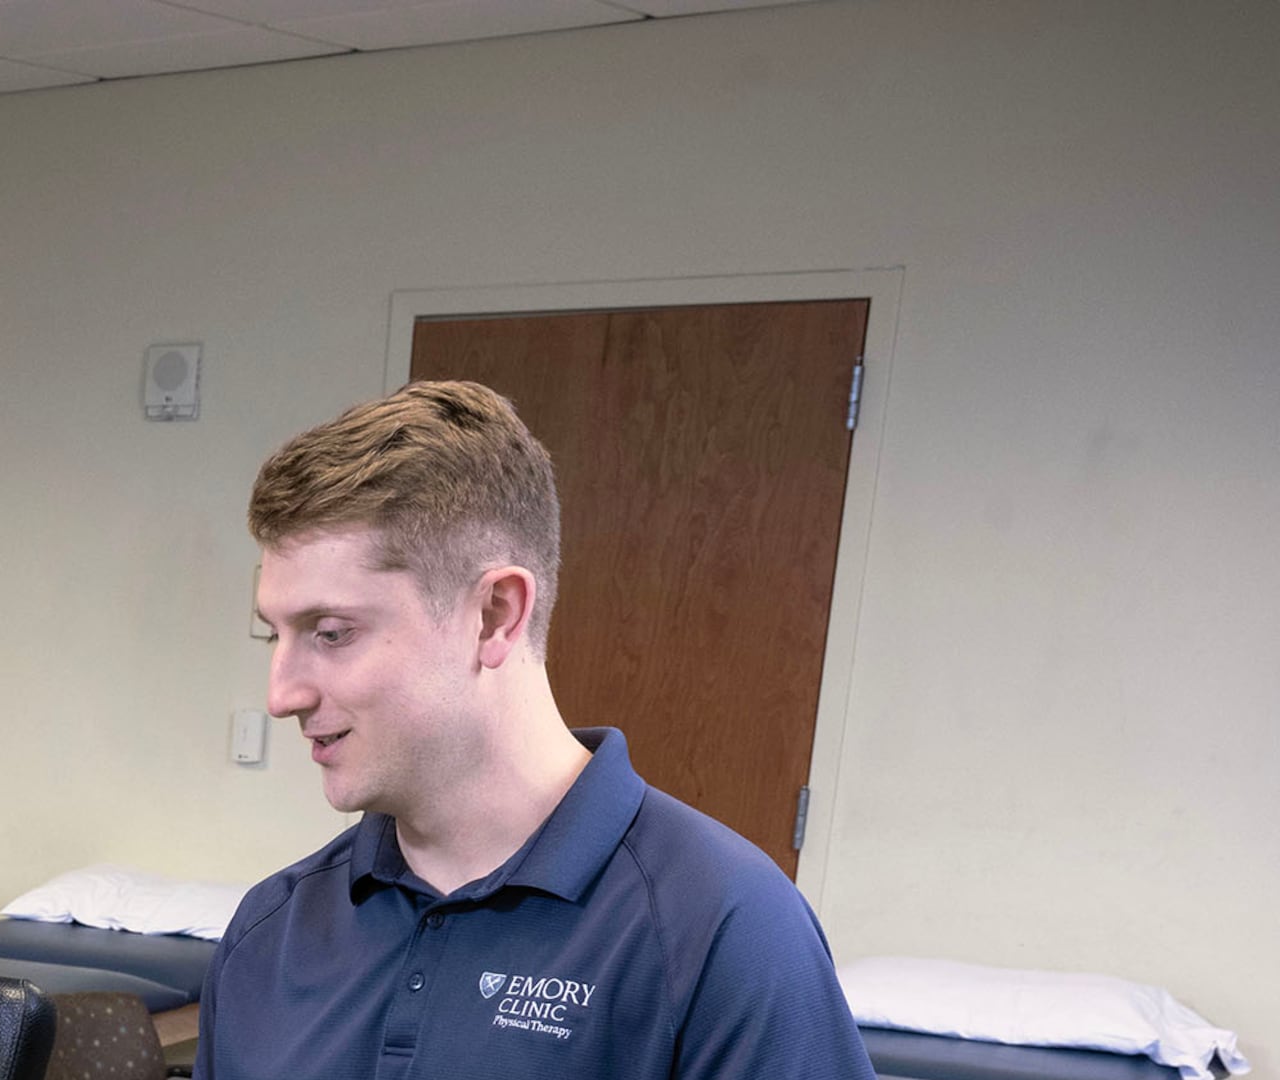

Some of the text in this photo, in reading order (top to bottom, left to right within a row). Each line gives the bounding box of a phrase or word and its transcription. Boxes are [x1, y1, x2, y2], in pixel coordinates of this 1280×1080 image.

[506, 975, 596, 1007] EMORY
[498, 998, 567, 1021] CLINIC
[492, 1015, 572, 1039] Physical Therapy
